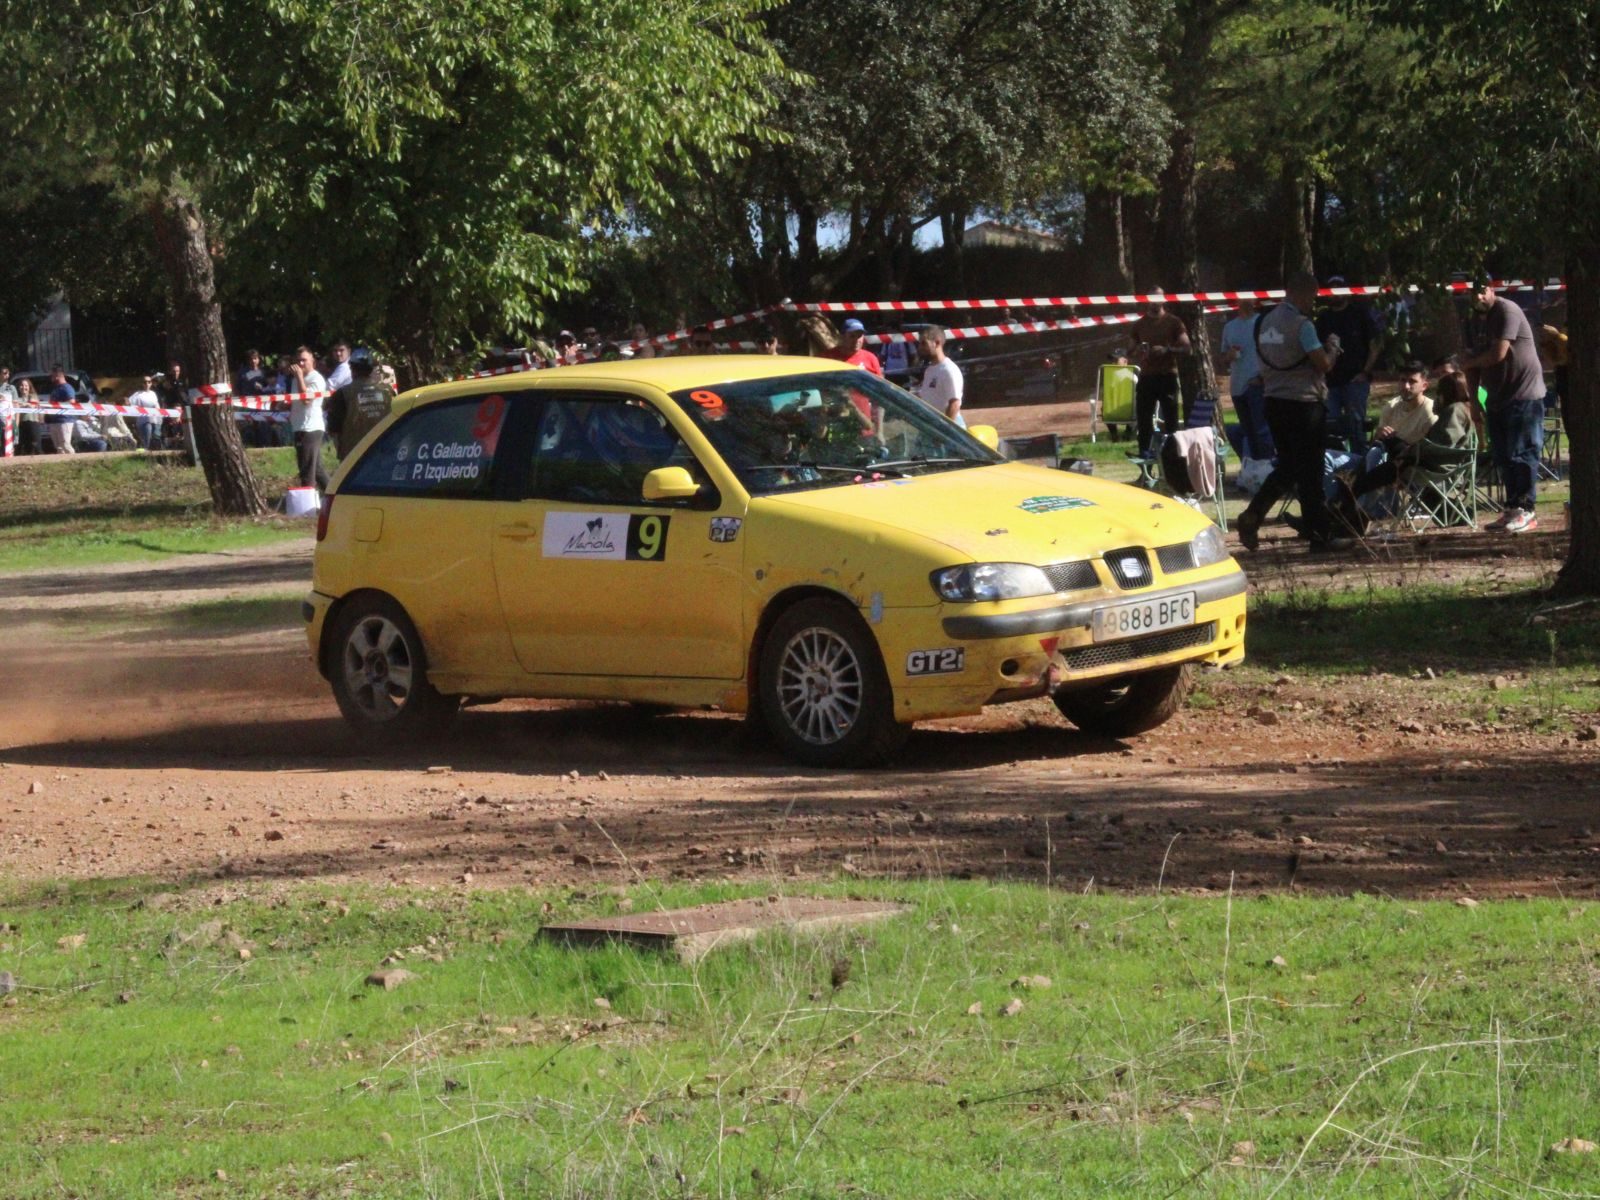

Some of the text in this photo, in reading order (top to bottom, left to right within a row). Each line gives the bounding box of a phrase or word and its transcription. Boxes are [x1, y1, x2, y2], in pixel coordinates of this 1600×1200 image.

[690, 390, 723, 408] 9
[471, 394, 505, 438] 9
[417, 442, 482, 460] C. Gallardo
[412, 462, 479, 483] P. Izquierdo
[563, 530, 615, 554] Mariola
[638, 516, 662, 559] 9
[1106, 597, 1190, 634] 9888 BFC
